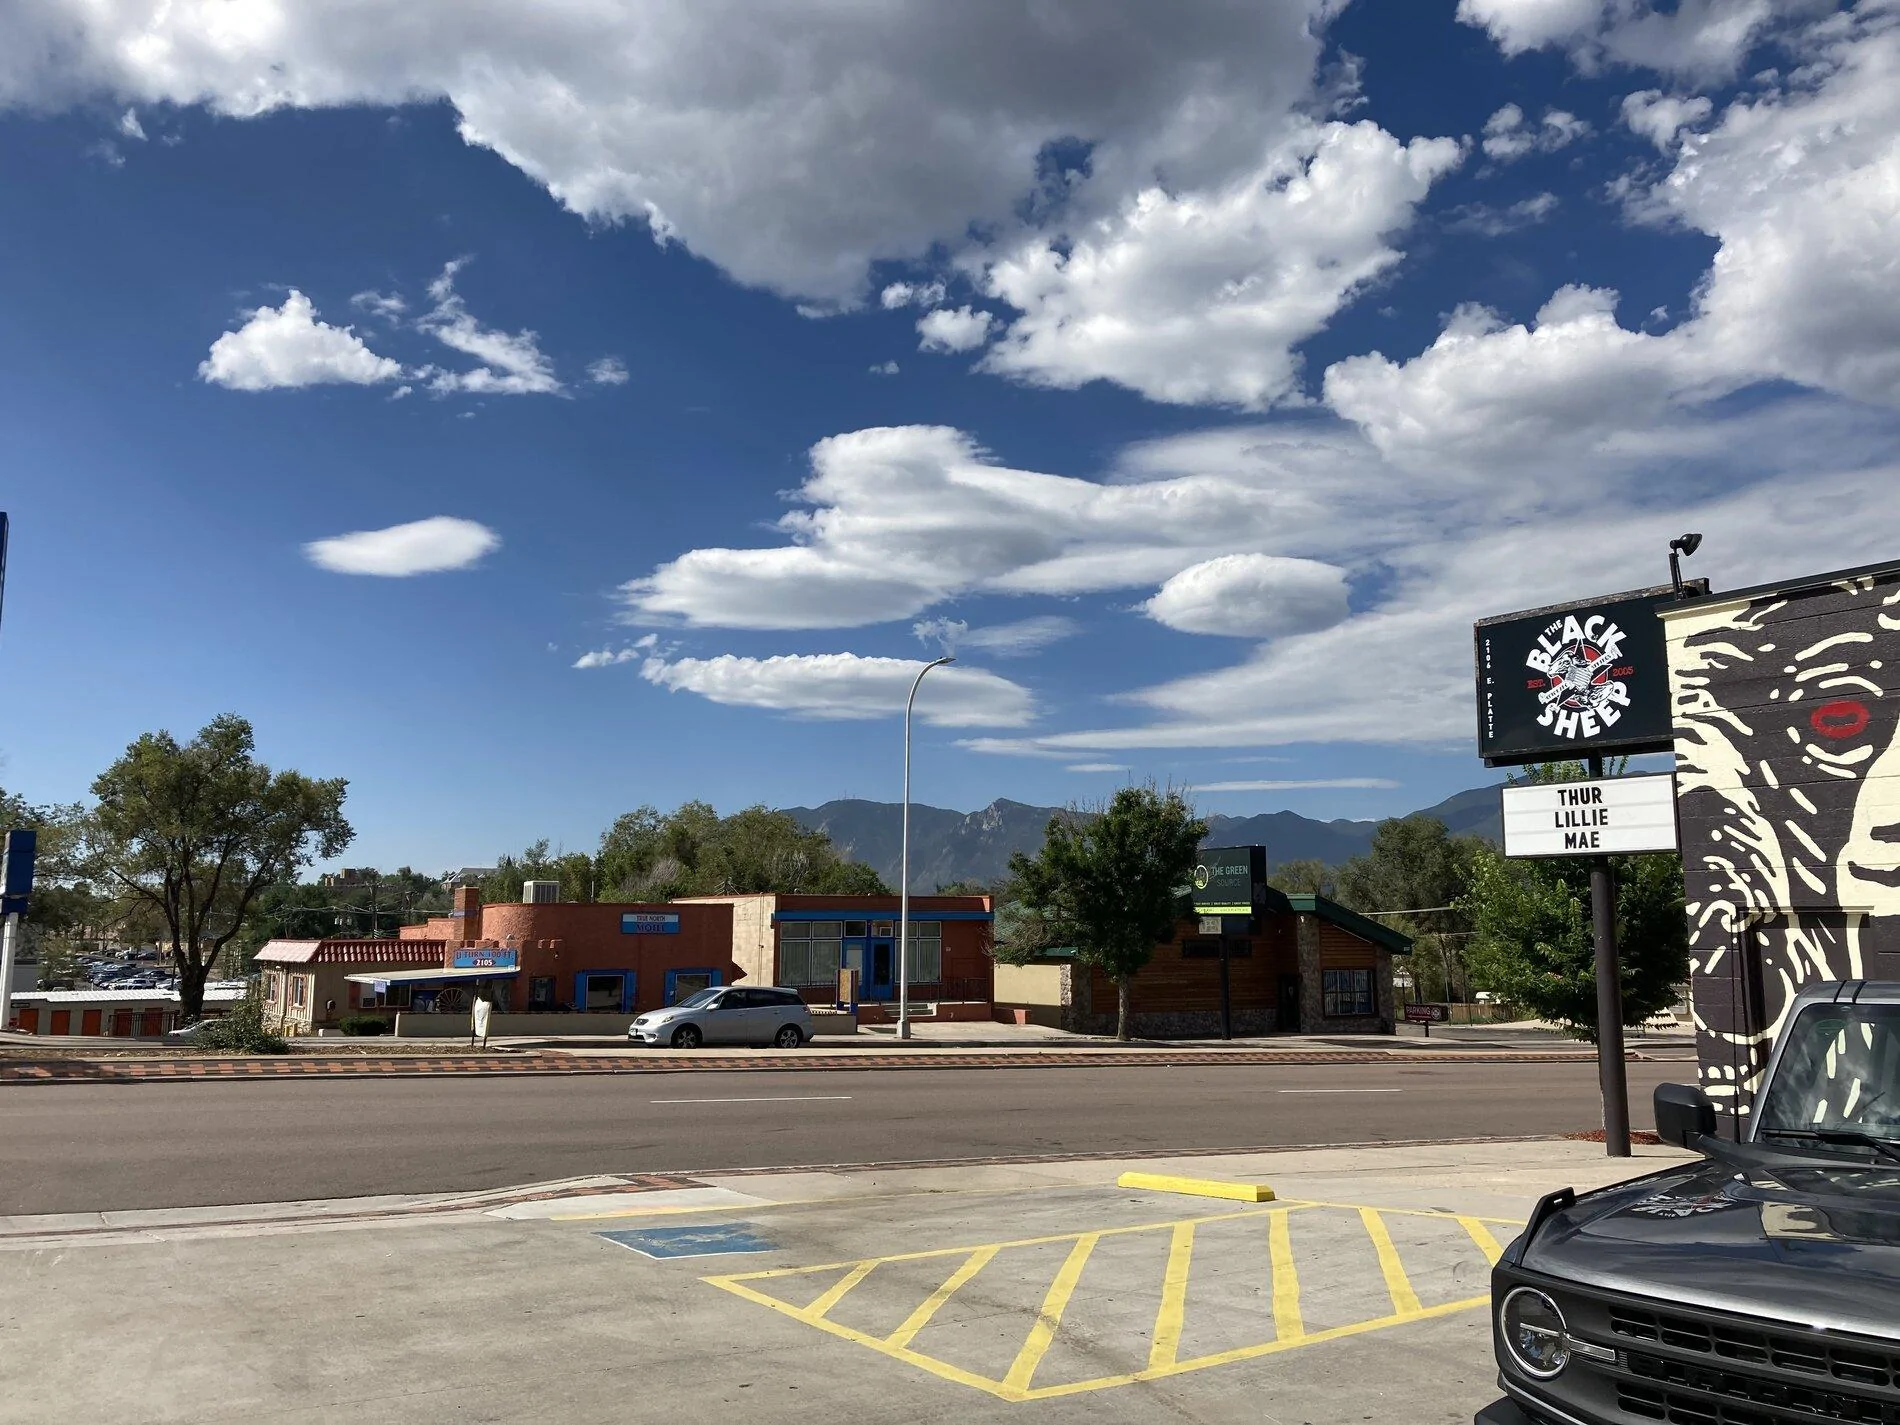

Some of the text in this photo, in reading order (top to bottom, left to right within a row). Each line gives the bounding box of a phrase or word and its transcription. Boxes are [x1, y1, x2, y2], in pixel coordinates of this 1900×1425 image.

[1544, 619, 1563, 636] THE
[1525, 614, 1628, 673] BLACK
[1526, 666, 1634, 689] EST. 2005
[1484, 639, 1495, 739] 2106 E. PLATTE
[1536, 680, 1631, 739] SHEEP
[1557, 786, 1602, 807] THUR
[1555, 808, 1609, 828] LILLIE
[1564, 831, 1600, 849] MAE
[1211, 865, 1248, 876] THE GREEN
[1217, 878, 1241, 887] SOURCE
[636, 923, 664, 931] MOTEL
[1406, 1006, 1431, 1015] PARKING
